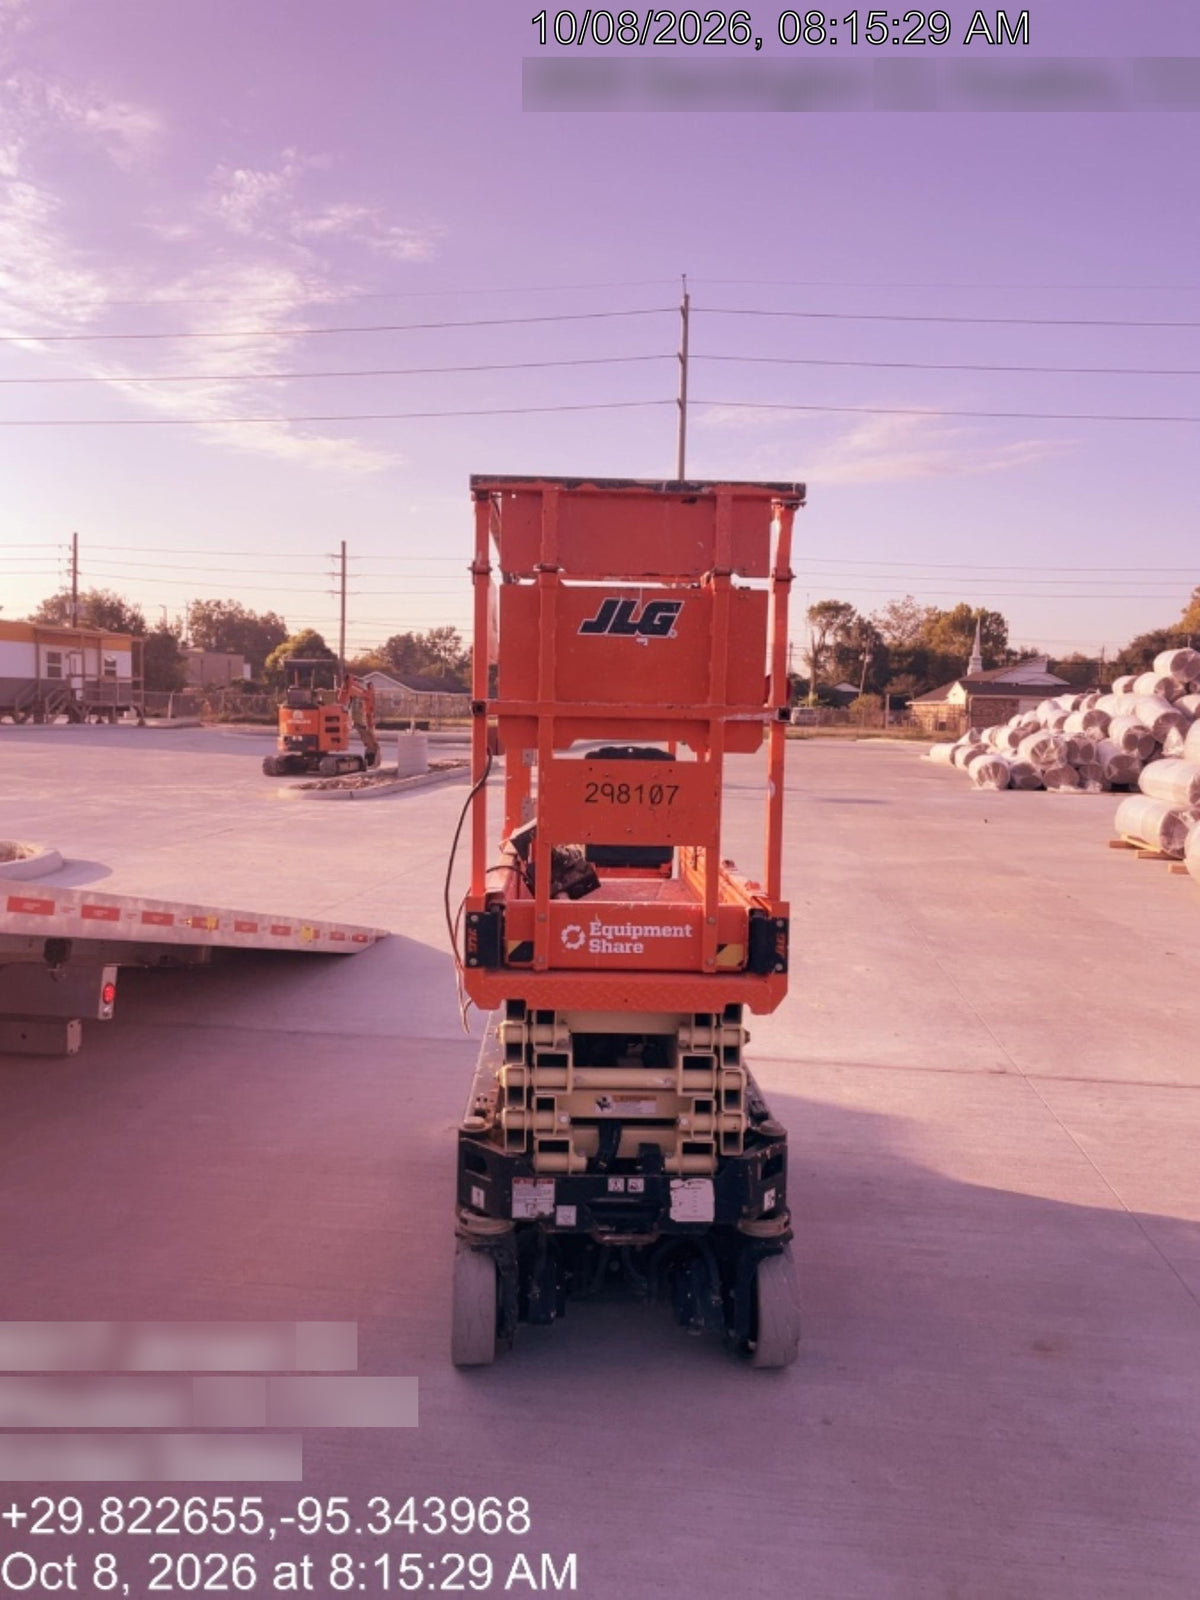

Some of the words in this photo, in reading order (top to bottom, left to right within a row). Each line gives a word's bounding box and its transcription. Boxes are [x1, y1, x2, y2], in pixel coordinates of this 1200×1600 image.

[577, 597, 684, 637] JLG
[584, 782, 680, 806] 298107
[589, 920, 693, 940] Equipment
[588, 938, 644, 954] Share
